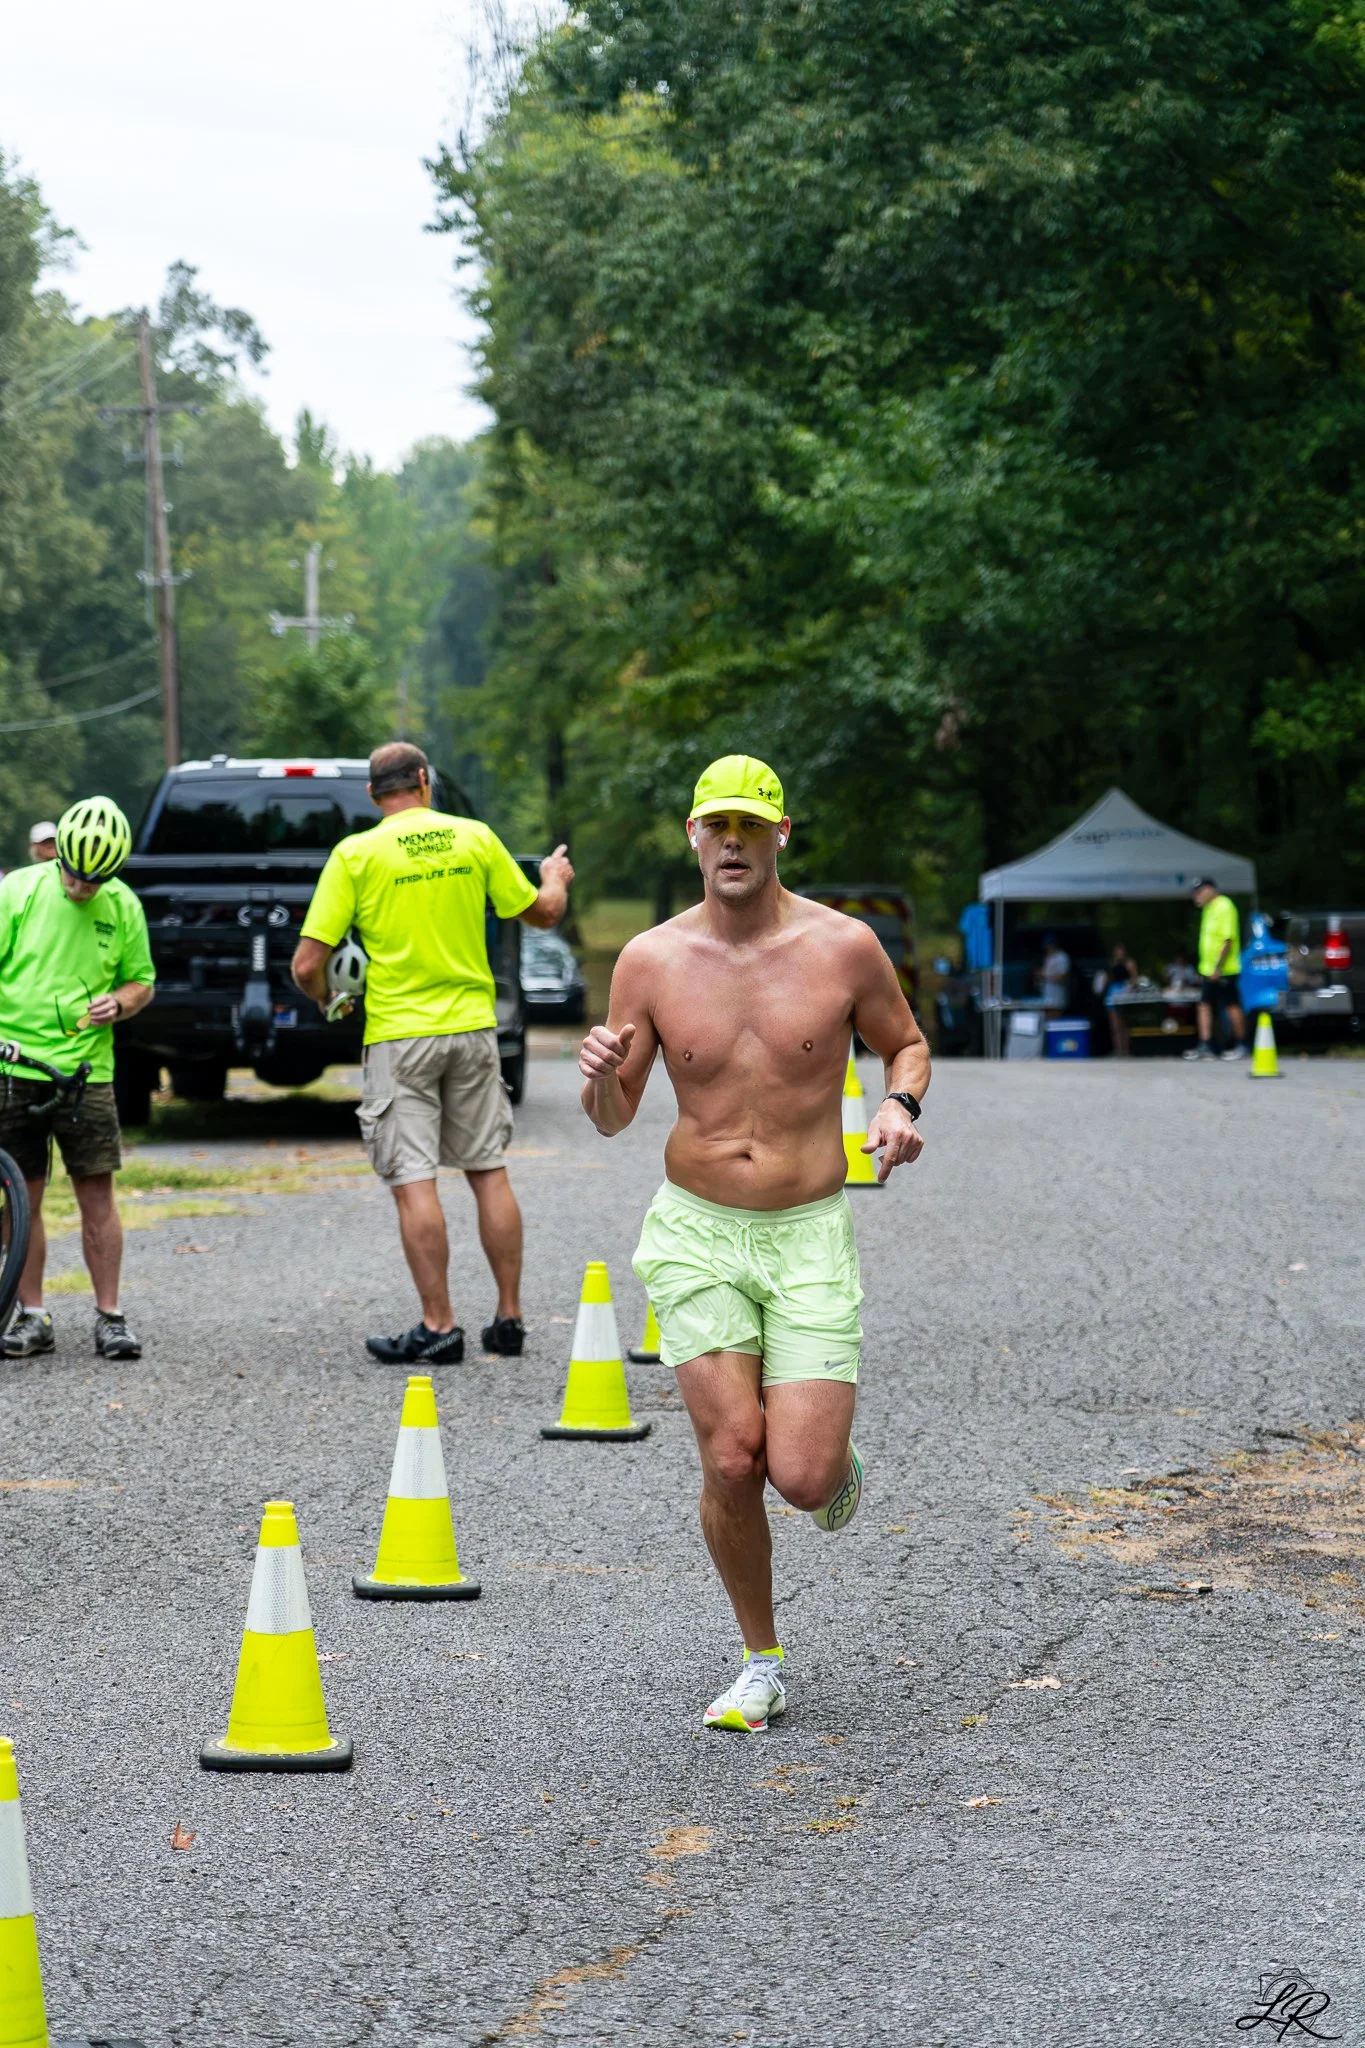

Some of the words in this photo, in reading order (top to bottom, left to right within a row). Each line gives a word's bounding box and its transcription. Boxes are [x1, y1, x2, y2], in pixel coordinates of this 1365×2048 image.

[397, 829, 456, 846] MEMPHIS
[426, 869, 445, 880] LINE
[448, 866, 473, 876] CREW
